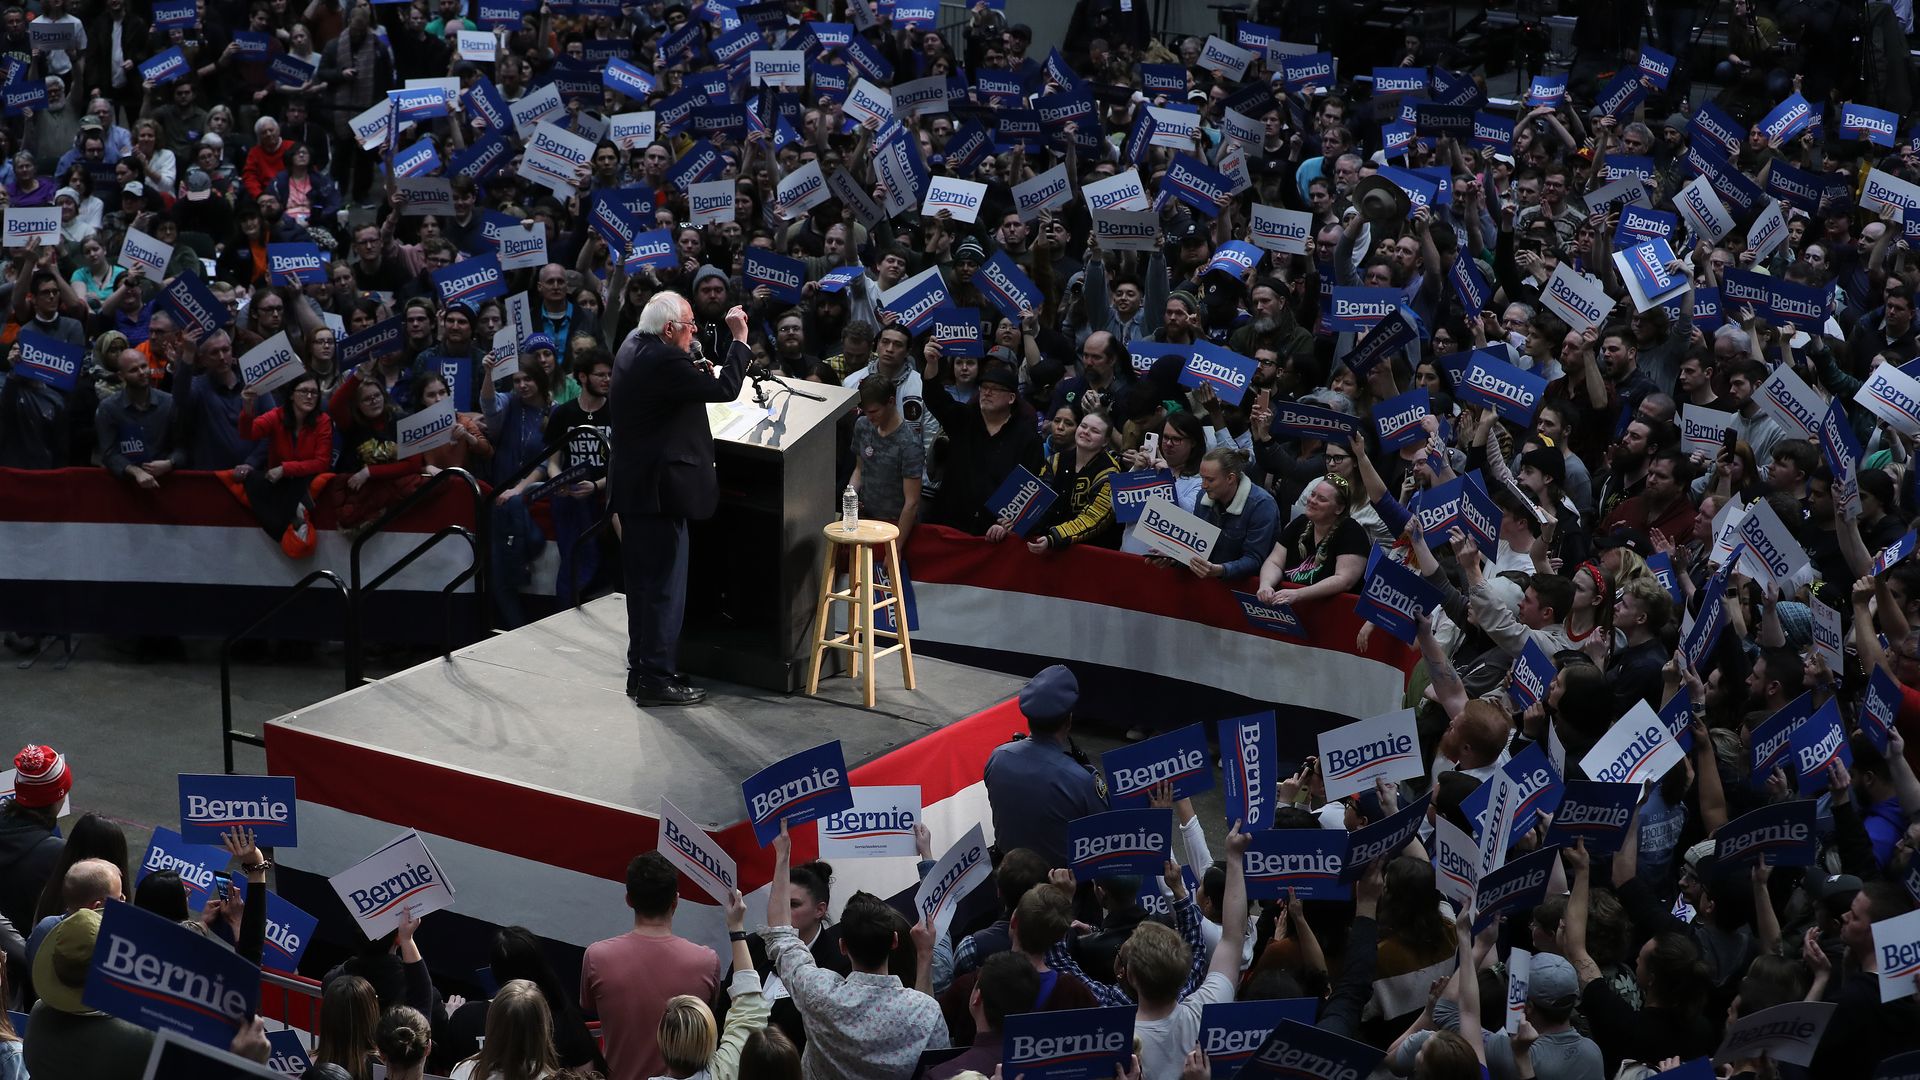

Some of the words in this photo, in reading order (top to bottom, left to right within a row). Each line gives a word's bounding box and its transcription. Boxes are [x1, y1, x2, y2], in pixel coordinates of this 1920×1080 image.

[155, 7, 195, 21] Bernie
[480, 6, 520, 20] Bernie
[895, 7, 935, 19] Bernie
[32, 30, 72, 41] Bernie
[461, 39, 497, 51] Berni
[667, 26, 700, 56] Bernie
[715, 31, 760, 59] Bernie
[817, 31, 850, 44] ernie
[143, 54, 182, 80] Bernie
[755, 62, 800, 74] Bernie
[847, 42, 883, 80] Bernie
[1048, 55, 1073, 92] Bernie
[1206, 46, 1245, 71] Bernie
[1287, 62, 1330, 80] Bernie
[1640, 54, 1669, 77] Bernie
[608, 67, 650, 93] Bernie
[705, 81, 726, 94] nie
[816, 72, 845, 89] Bernie
[979, 79, 1020, 94] Bernie
[1144, 73, 1184, 89] Bernie
[1376, 78, 1423, 91] Bernie
[1533, 82, 1565, 98] Bernie
[6, 88, 45, 106] Bernie
[470, 86, 504, 129] Bernie
[516, 96, 558, 124] Bernie
[661, 95, 707, 122] Bernie
[896, 86, 944, 107] Bernie
[1039, 100, 1092, 121] Bernie
[1602, 79, 1638, 114] Bernie
[358, 113, 390, 138] Bern
[613, 122, 651, 137] Bernie
[695, 115, 743, 130] Bernie
[1000, 119, 1040, 132] Berni
[1225, 119, 1260, 142] Bernie
[1421, 112, 1472, 127] Bernie
[1474, 122, 1510, 142] Bernie
[1696, 110, 1738, 145] Bernie
[1767, 103, 1808, 137] Bernie
[1845, 113, 1893, 134] Bernie
[461, 141, 504, 177] Bernie
[535, 133, 586, 164] Bernie
[951, 130, 985, 161] Bernie
[675, 149, 717, 190] Bernie
[896, 140, 919, 193] Bernie
[1689, 146, 1718, 177] Bernie
[779, 172, 821, 204] Bernie
[880, 154, 905, 206] Bernie
[1020, 178, 1066, 209] Bernie
[1091, 183, 1140, 208] Bernie
[1169, 163, 1223, 200] Bernie
[1715, 173, 1752, 209] Bernie
[1772, 170, 1818, 200] Bernie
[1867, 181, 1917, 209] Bernie
[693, 193, 732, 209] Bernie
[837, 176, 875, 221] Bernie
[930, 188, 977, 208] Bernie
[1687, 186, 1723, 236] Bernie
[7, 218, 57, 233] Bernie
[596, 199, 633, 241] Bernie
[1097, 220, 1155, 236] Bernie
[1254, 216, 1306, 239] Bernie
[1625, 213, 1671, 236] Bernie
[124, 240, 165, 269] Bernie
[272, 253, 320, 270] Bernie
[505, 238, 544, 254] Bernie
[747, 259, 800, 288] Bernie
[1639, 243, 1671, 289] Bernie
[441, 267, 499, 297] Bernie
[983, 261, 1032, 309] Bernie
[1457, 259, 1482, 310] Bernie
[171, 280, 216, 332] Bernie
[898, 288, 945, 326] Bernie
[1336, 300, 1396, 316] Bernie
[1551, 276, 1600, 322] Bernie
[1771, 293, 1822, 319] Bernie
[342, 327, 399, 360] Bernie
[936, 322, 978, 340] Bernie
[22, 343, 75, 375] Bernie
[244, 348, 292, 382] Bernie
[1189, 352, 1246, 388] Bernie
[1468, 365, 1534, 408] Bernie
[1281, 410, 1352, 432] Bernie
[1379, 404, 1426, 435] Bernie
[1767, 378, 1820, 435] Bernie
[401, 413, 453, 444] Bernie
[1825, 409, 1852, 470] Bernie
[569, 440, 600, 454] NEW
[998, 479, 1040, 521] Bernie
[1145, 508, 1208, 552] Bernie
[1461, 491, 1497, 541] Bernie
[1743, 514, 1790, 577] Bernie
[1368, 574, 1423, 620] Bernie
[1242, 601, 1297, 625] Bernie
[1688, 599, 1720, 662] Bernie
[1515, 656, 1545, 701] Bernie
[1867, 684, 1894, 729] Bernie
[1326, 732, 1412, 775] Bernie
[1597, 725, 1662, 783] Bernie
[1800, 722, 1843, 773] Bernie
[1113, 748, 1203, 792] Bernie
[1242, 721, 1264, 825] Bernie
[187, 795, 288, 820] Bernie
[751, 765, 840, 822] Bernie
[825, 805, 914, 832] Bernie
[1483, 781, 1508, 872] Bernie
[1561, 800, 1628, 826] Bernie
[664, 817, 733, 889] Bernie
[1073, 826, 1163, 860] Bernie
[1351, 815, 1421, 860] Bernie
[1720, 819, 1808, 858] Bernie
[146, 846, 215, 889] Bernie
[1244, 848, 1342, 873] Bernie
[349, 862, 433, 914] Bernie
[922, 845, 981, 921] Bernie
[1480, 867, 1545, 906] Bernie
[103, 933, 248, 1019] Bernie
[1012, 1024, 1125, 1061] Bernie
[1260, 1039, 1359, 1080] Bernie
